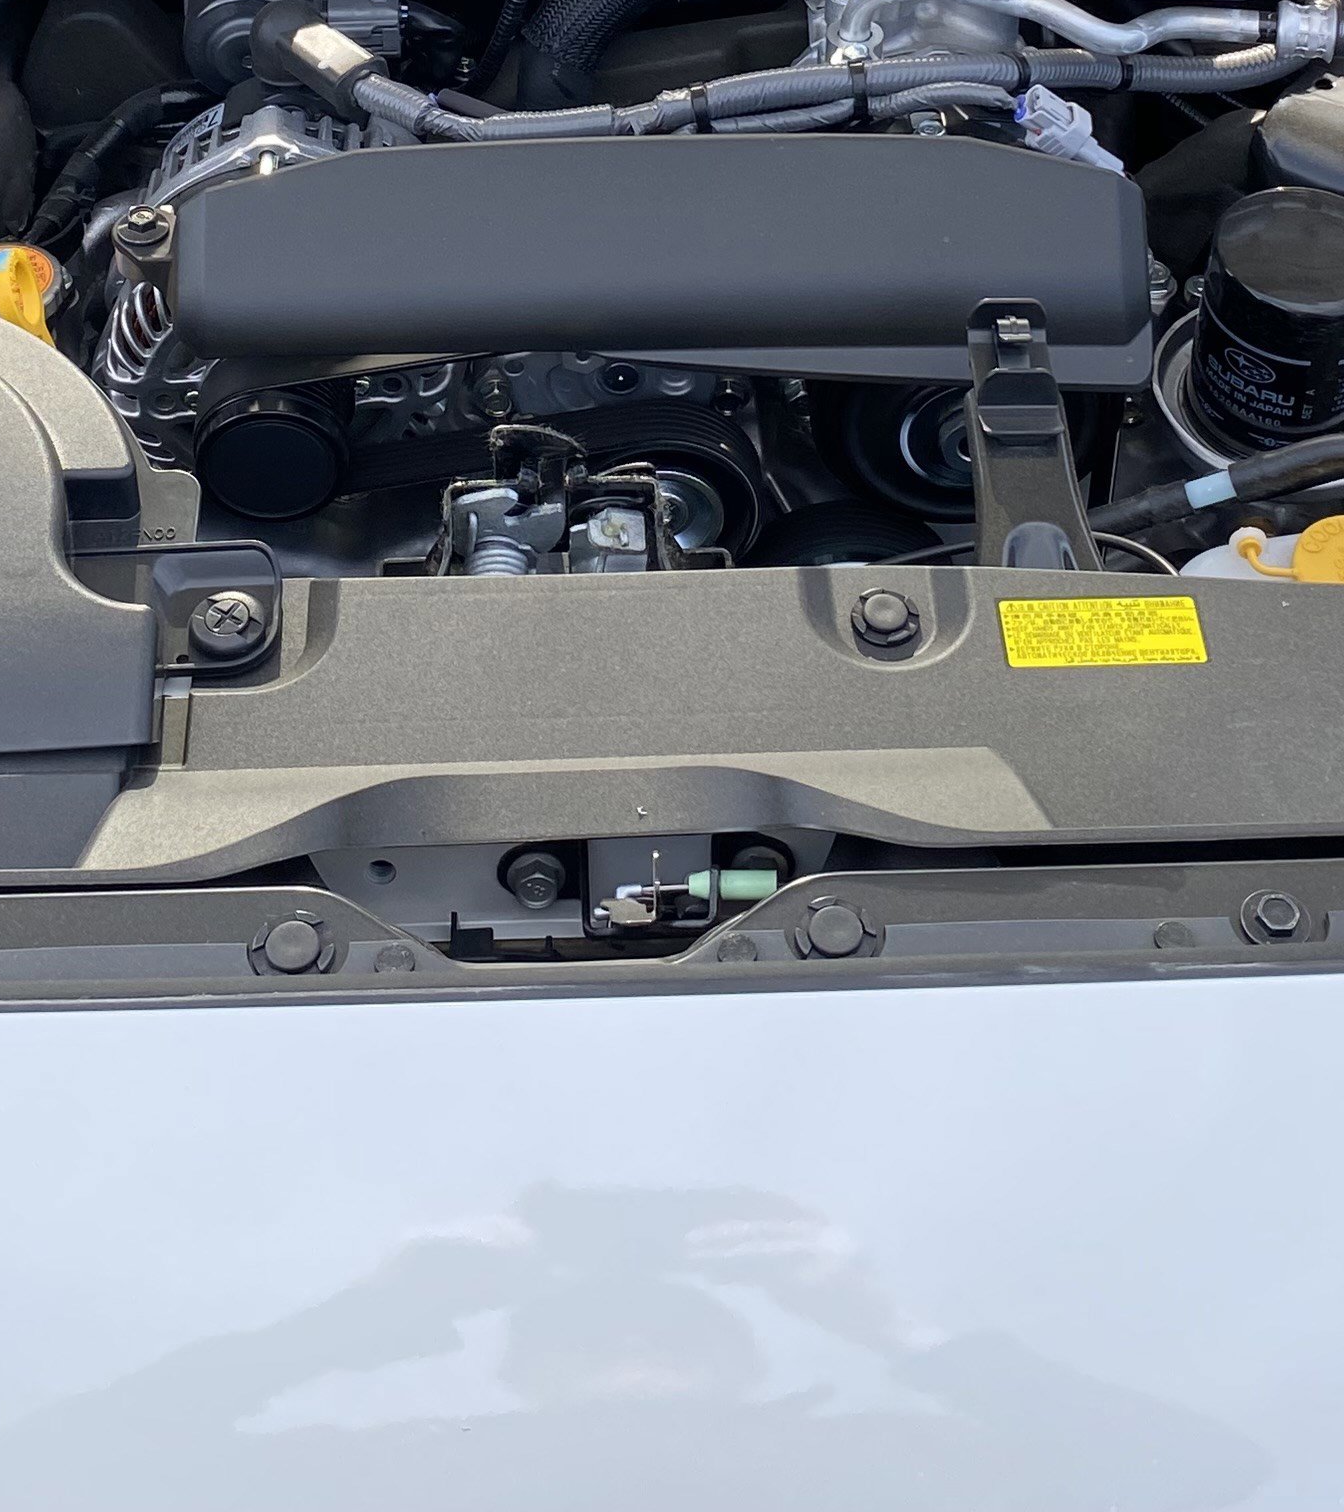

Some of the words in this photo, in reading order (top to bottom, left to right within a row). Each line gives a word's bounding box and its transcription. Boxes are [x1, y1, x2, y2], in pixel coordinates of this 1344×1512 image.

[1205, 366, 1231, 394] MADE
[1233, 390, 1247, 403] IN
[1249, 400, 1293, 417] JAPAN
[1207, 354, 1295, 406] SUBARU
